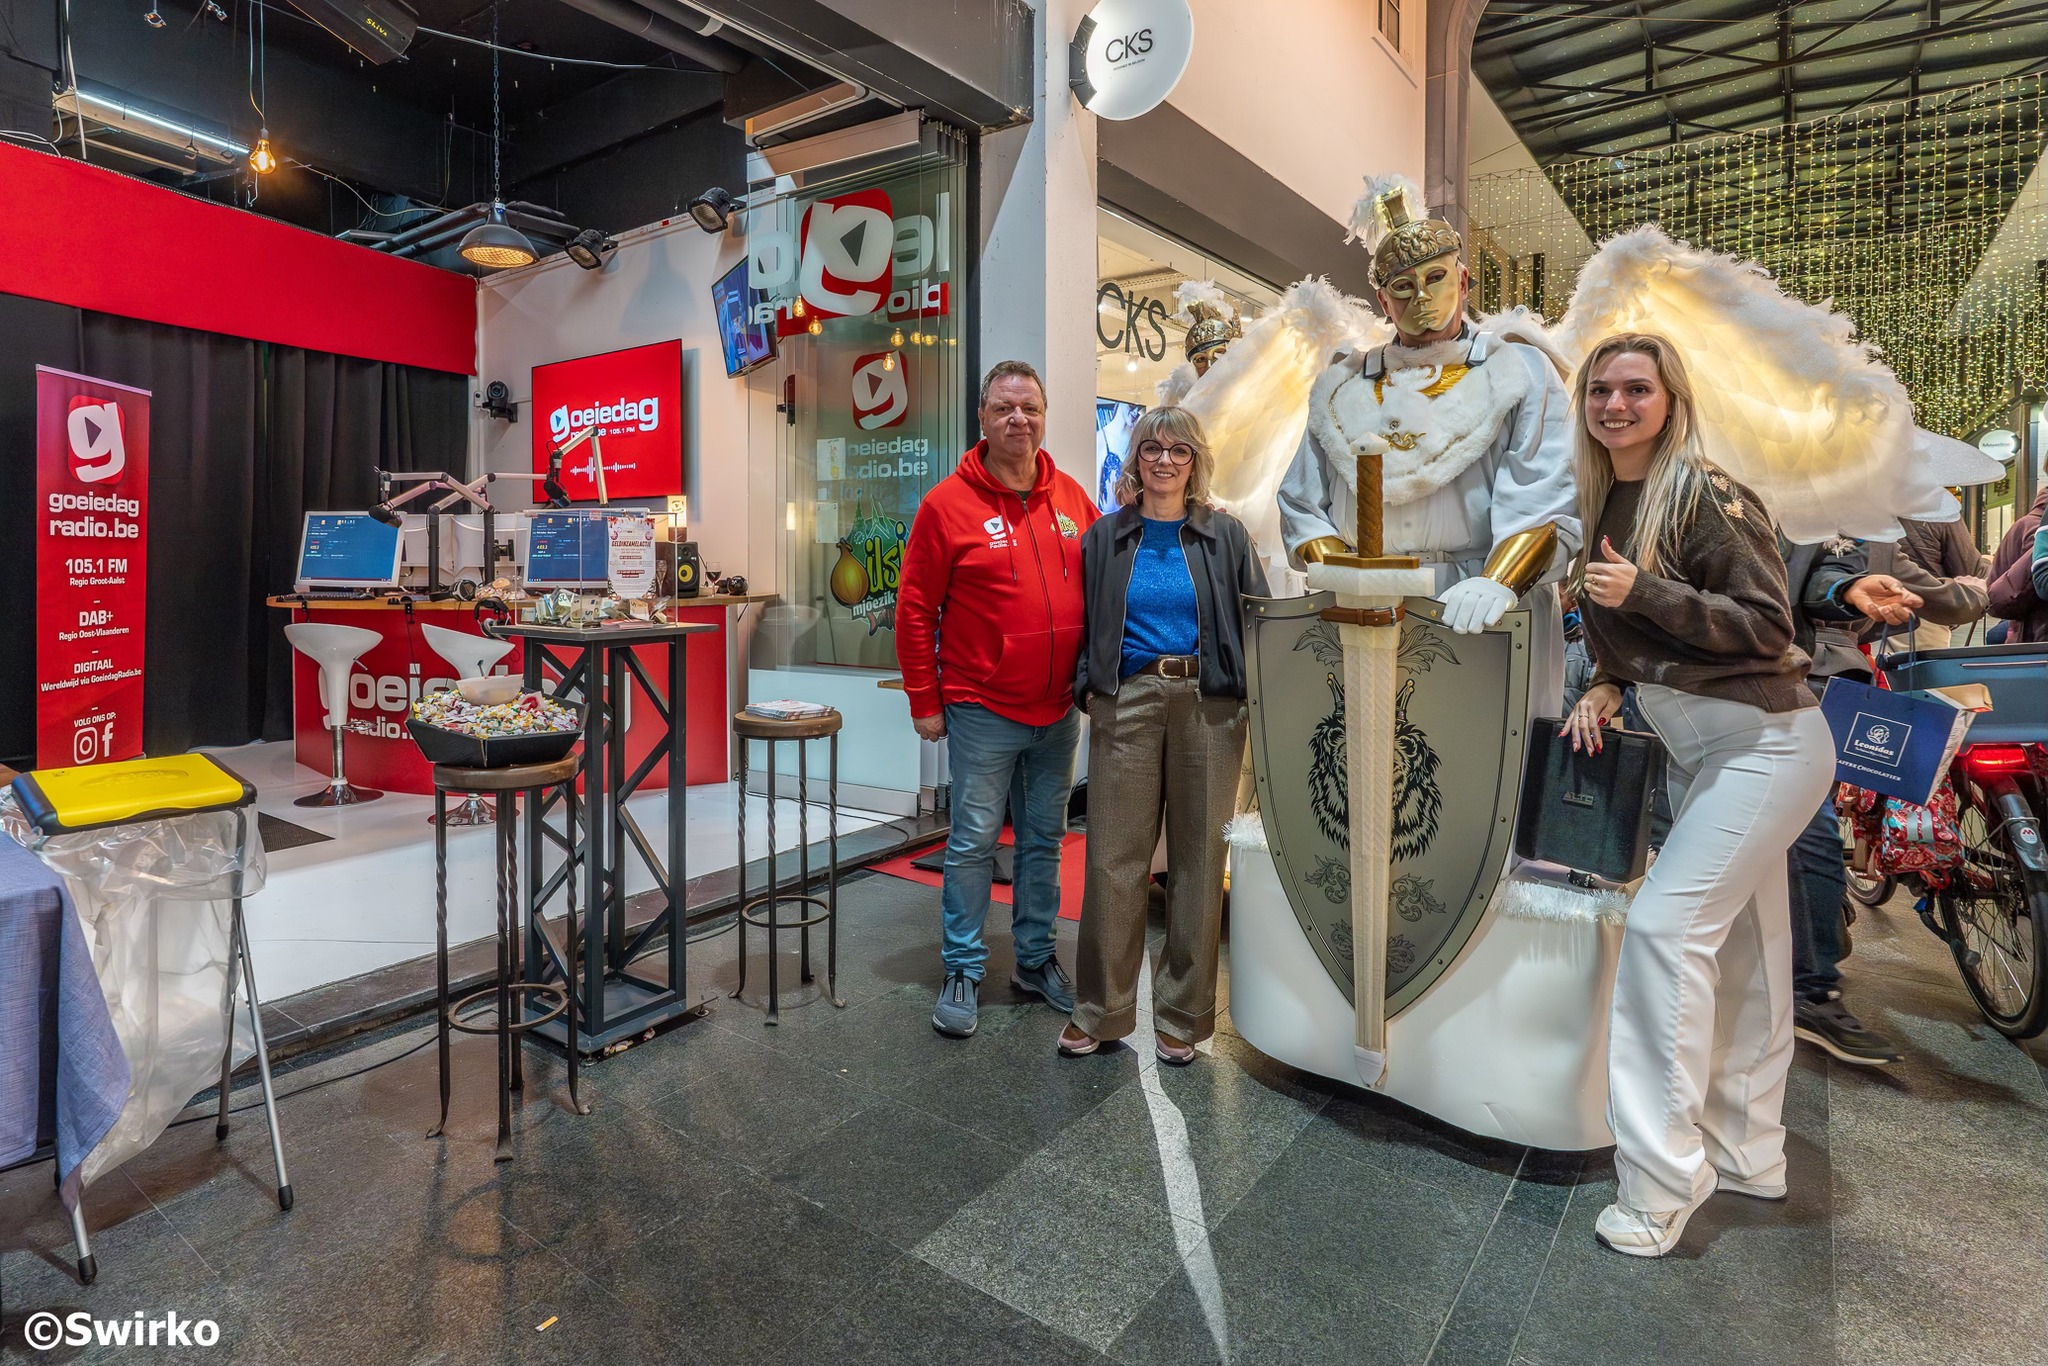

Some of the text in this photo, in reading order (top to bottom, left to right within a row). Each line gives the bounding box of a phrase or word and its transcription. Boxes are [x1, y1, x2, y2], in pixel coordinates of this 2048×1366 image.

[1105, 28, 1154, 63] CKS
[1096, 282, 1167, 362] CKS
[549, 397, 659, 443] goeiedag
[48, 491, 140, 517] goeiedag
[49, 516, 139, 538] radio.be
[65, 558, 128, 574] 105.1 FM
[69, 576, 126, 588] Regio Groot-Aalst
[79, 610, 114, 627] DAB+
[58, 627, 130, 642] Regio Oost-Vlaanderen
[73, 658, 114, 674] DIGITAAL
[40, 668, 142, 692] Wereldwijd via GoeiedagRadio.be
[73, 711, 117, 728] VOLG ONS OP:
[1854, 739, 1895, 756] Leonidas
